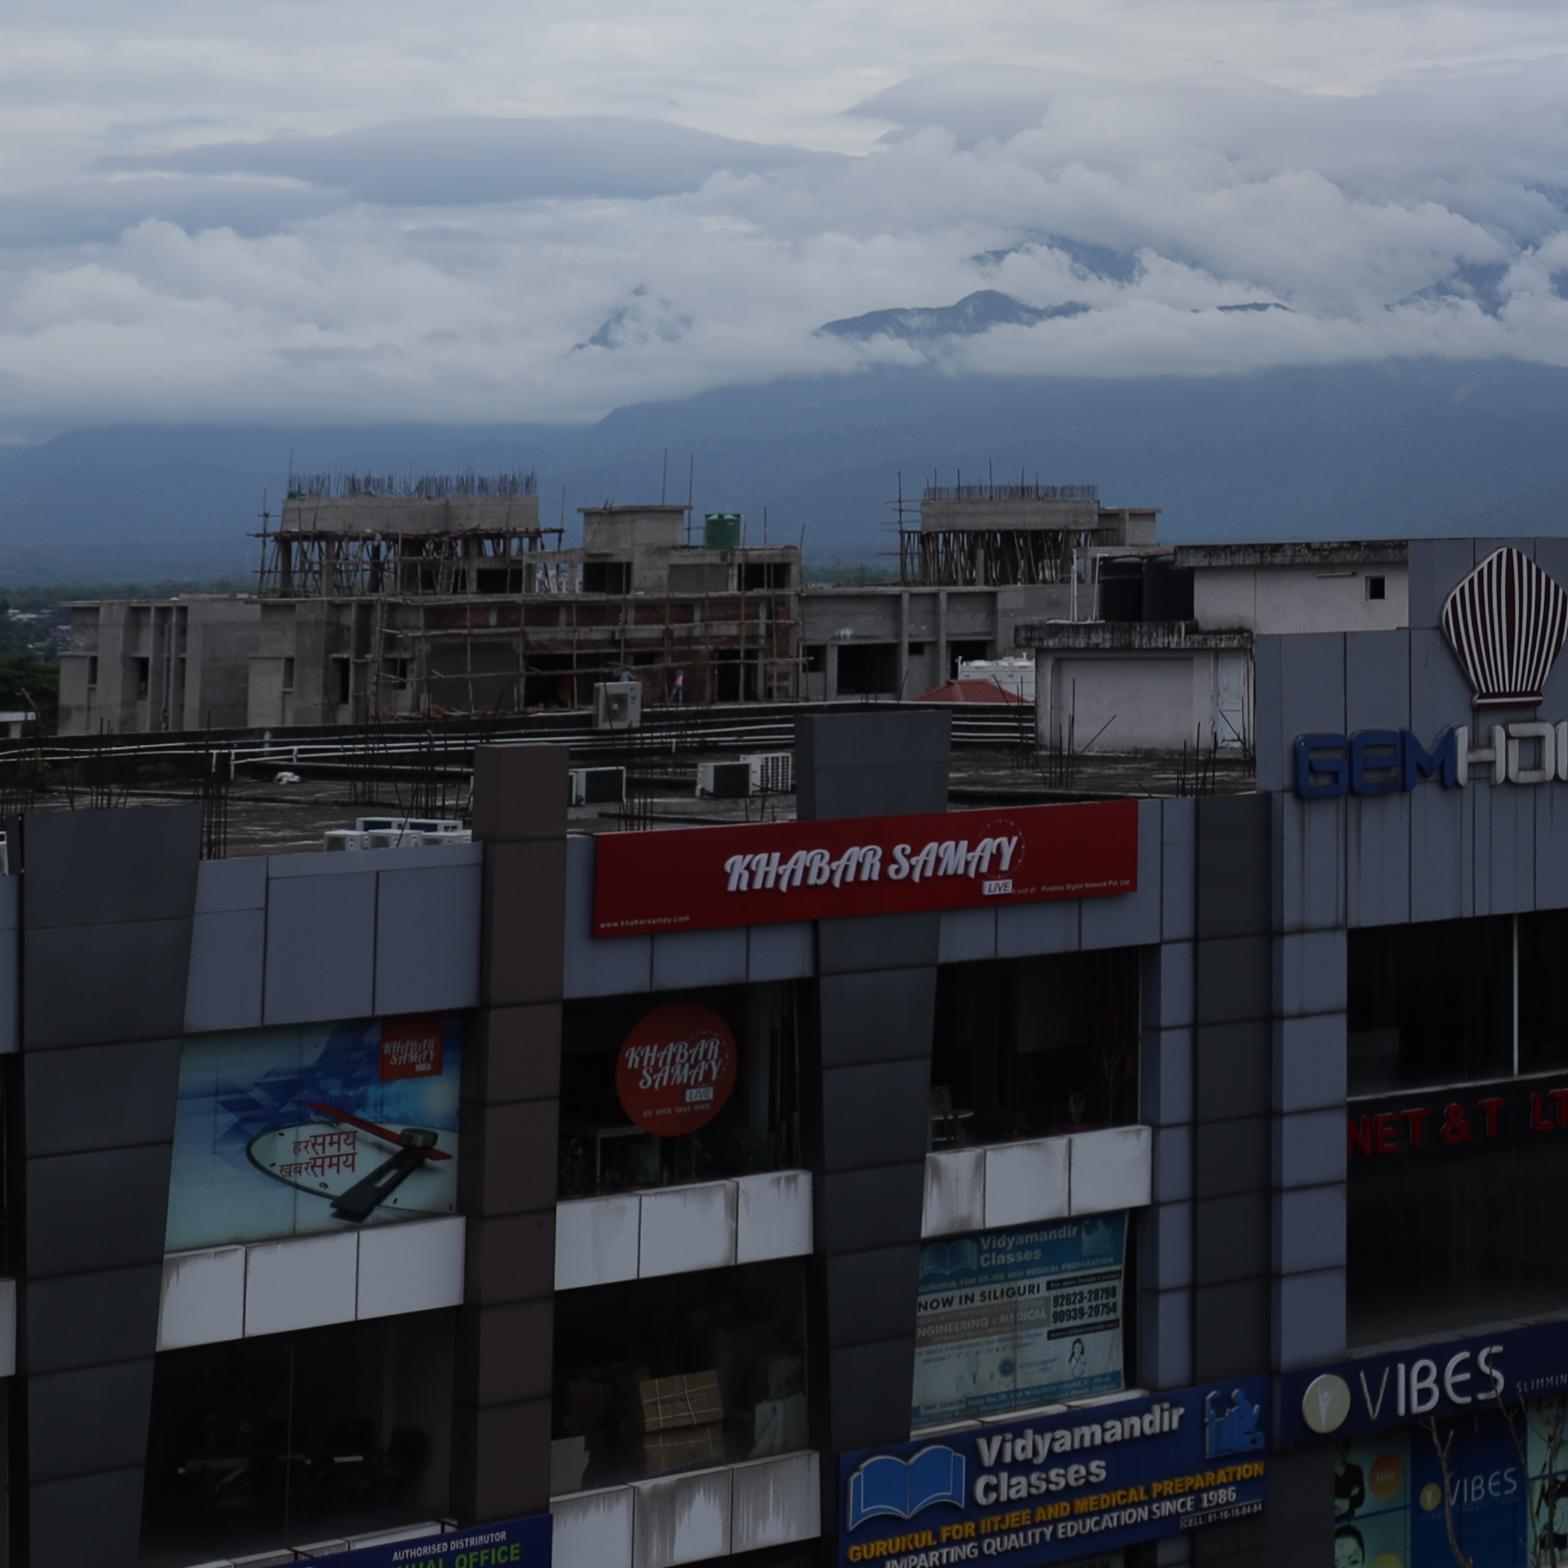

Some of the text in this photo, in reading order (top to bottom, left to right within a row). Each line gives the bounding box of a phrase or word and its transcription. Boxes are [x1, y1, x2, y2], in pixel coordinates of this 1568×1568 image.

[723, 836, 1019, 893] KHABAR SAMAY
[987, 882, 1012, 893] LIVE
[625, 1038, 720, 1070] KHABAR
[639, 1058, 722, 1090] SAMAY
[1347, 1106, 1432, 1159] NET
[1441, 1101, 1473, 1145] &
[1478, 1096, 1507, 1138] T
[980, 1225, 1079, 1250] Vidyamandir
[980, 1248, 1042, 1268] Classes
[918, 1295, 955, 1312] NOW
[959, 1292, 975, 1306] IN
[980, 1283, 1041, 1302] SILIGURI
[1360, 1345, 1504, 1422] VIBES
[976, 1401, 1186, 1468] Vidyamandir
[974, 1458, 1108, 1508] Classes
[1448, 1467, 1517, 1507] VIBES
[848, 1529, 937, 1563] GURUKUL
[941, 1521, 976, 1543] FOR
[1035, 1500, 1071, 1523] AND
[1072, 1485, 1149, 1515] MEDICAL
[1151, 1461, 1264, 1499] PREPARATION
[982, 1524, 1053, 1556] QUALITY
[1056, 1507, 1149, 1539] EDUCATION
[1152, 1496, 1195, 1518] SINCE
[1200, 1486, 1237, 1509] 1986
[392, 1530, 507, 1562] AUTHORISED DISTRIBUTOR
[455, 1542, 520, 1568] OFFICE
